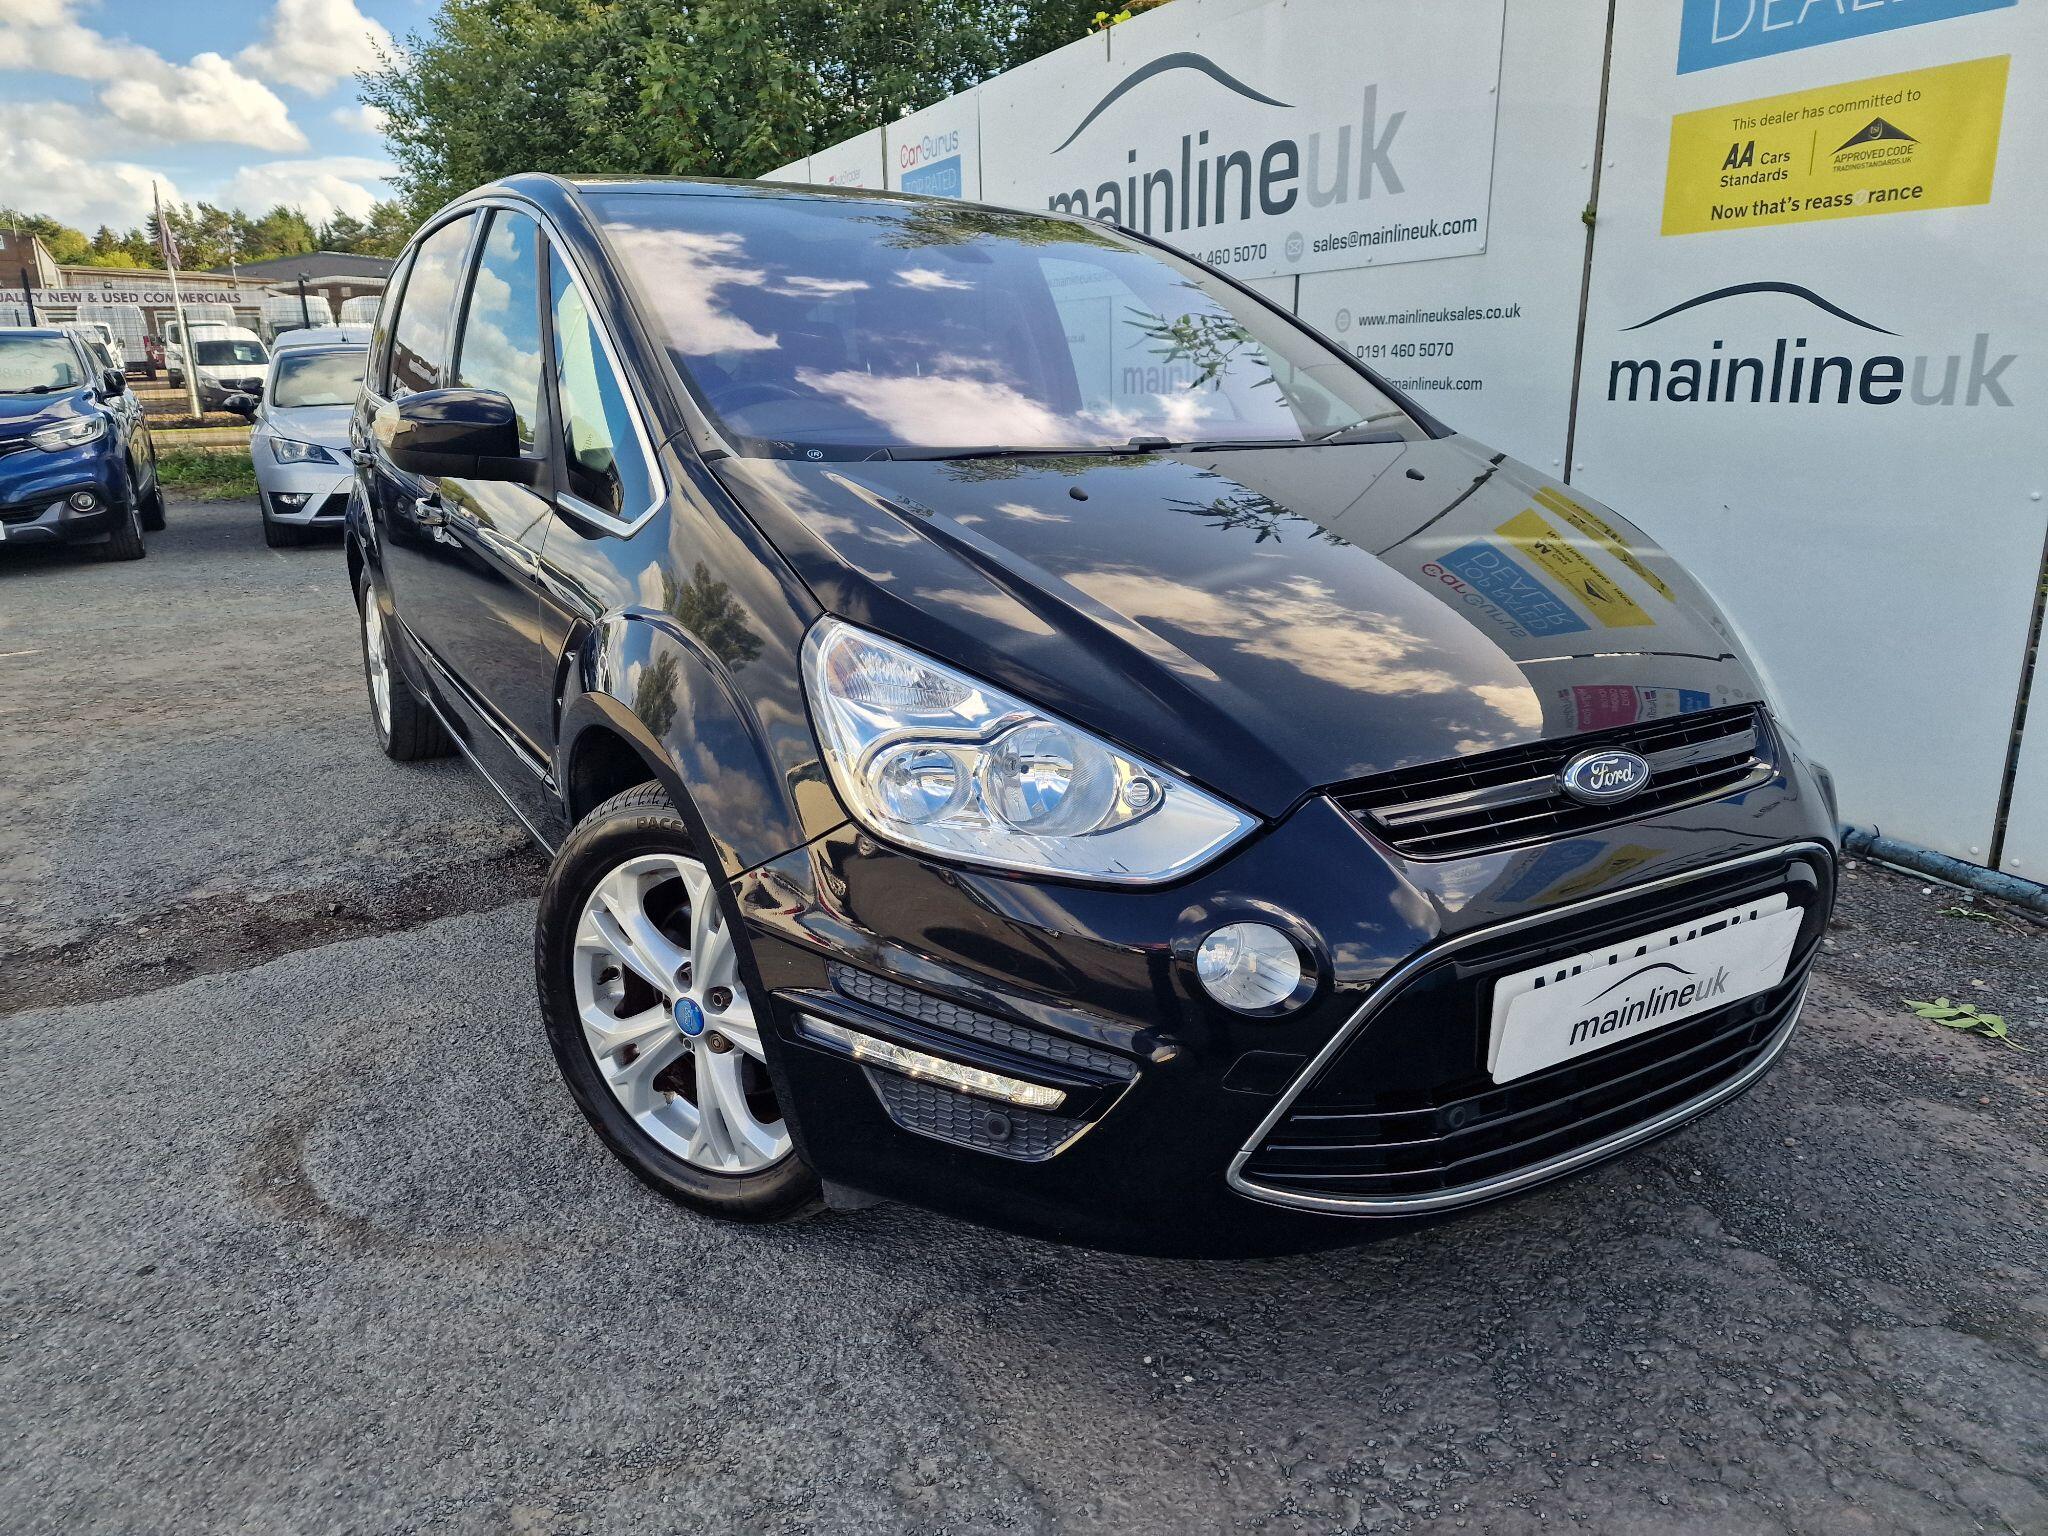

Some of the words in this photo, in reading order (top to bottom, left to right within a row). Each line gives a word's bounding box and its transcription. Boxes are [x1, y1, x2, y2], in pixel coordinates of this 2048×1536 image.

[1733, 118, 1756, 131] This
[1760, 110, 1799, 127] dealer
[1802, 105, 1824, 120] has
[1828, 90, 1903, 115] committed
[1907, 89, 1921, 101] to
[900, 130, 959, 169] CarGurus
[1721, 140, 1755, 171] AA
[1760, 150, 1791, 165] Cars
[1833, 147, 1885, 164] APPROVED
[1887, 144, 1914, 156] CODE
[1720, 167, 1788, 188] Standards
[1833, 156, 1912, 173] TRADINGSTANDARDS.UK
[1711, 204, 1748, 221] Now
[1805, 185, 1923, 211] reassrance
[1313, 217, 1477, 253] sales@mainlineuk.com
[1207, 248, 1230, 266] 460
[1234, 243, 1267, 263] 5070
[50, 292, 82, 303] NEW
[88, 292, 98, 303] &
[102, 292, 139, 303] USED
[143, 292, 242, 304] COMMERCIALS
[1358, 303, 1521, 326] www.mainlineuksales.co.uk
[1357, 345, 1386, 359] 0191
[1390, 343, 1415, 357] 460
[1419, 342, 1454, 357] 5070
[1385, 376, 1483, 391] mainlineuk.com
[1607, 332, 2019, 408] mainlineuk
[1590, 758, 1634, 790] Ford
[1569, 966, 1730, 1046] mainlineuk
